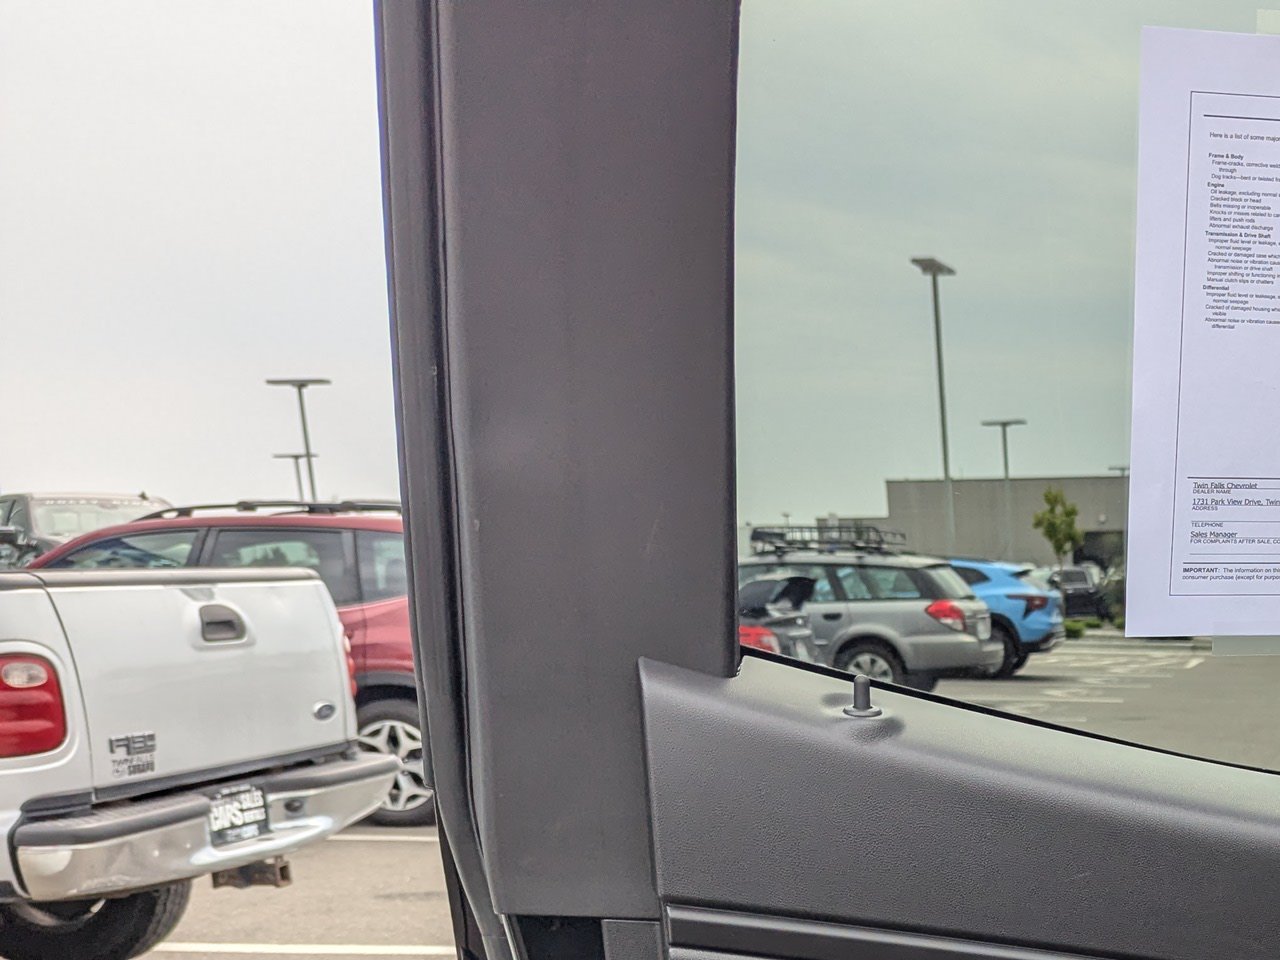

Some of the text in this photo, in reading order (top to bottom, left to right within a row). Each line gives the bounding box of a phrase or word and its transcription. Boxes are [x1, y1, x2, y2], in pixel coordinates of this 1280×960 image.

[1265, 136, 1280, 144] major
[1243, 498, 1263, 507] Drive,
[1208, 531, 1237, 539] Manager
